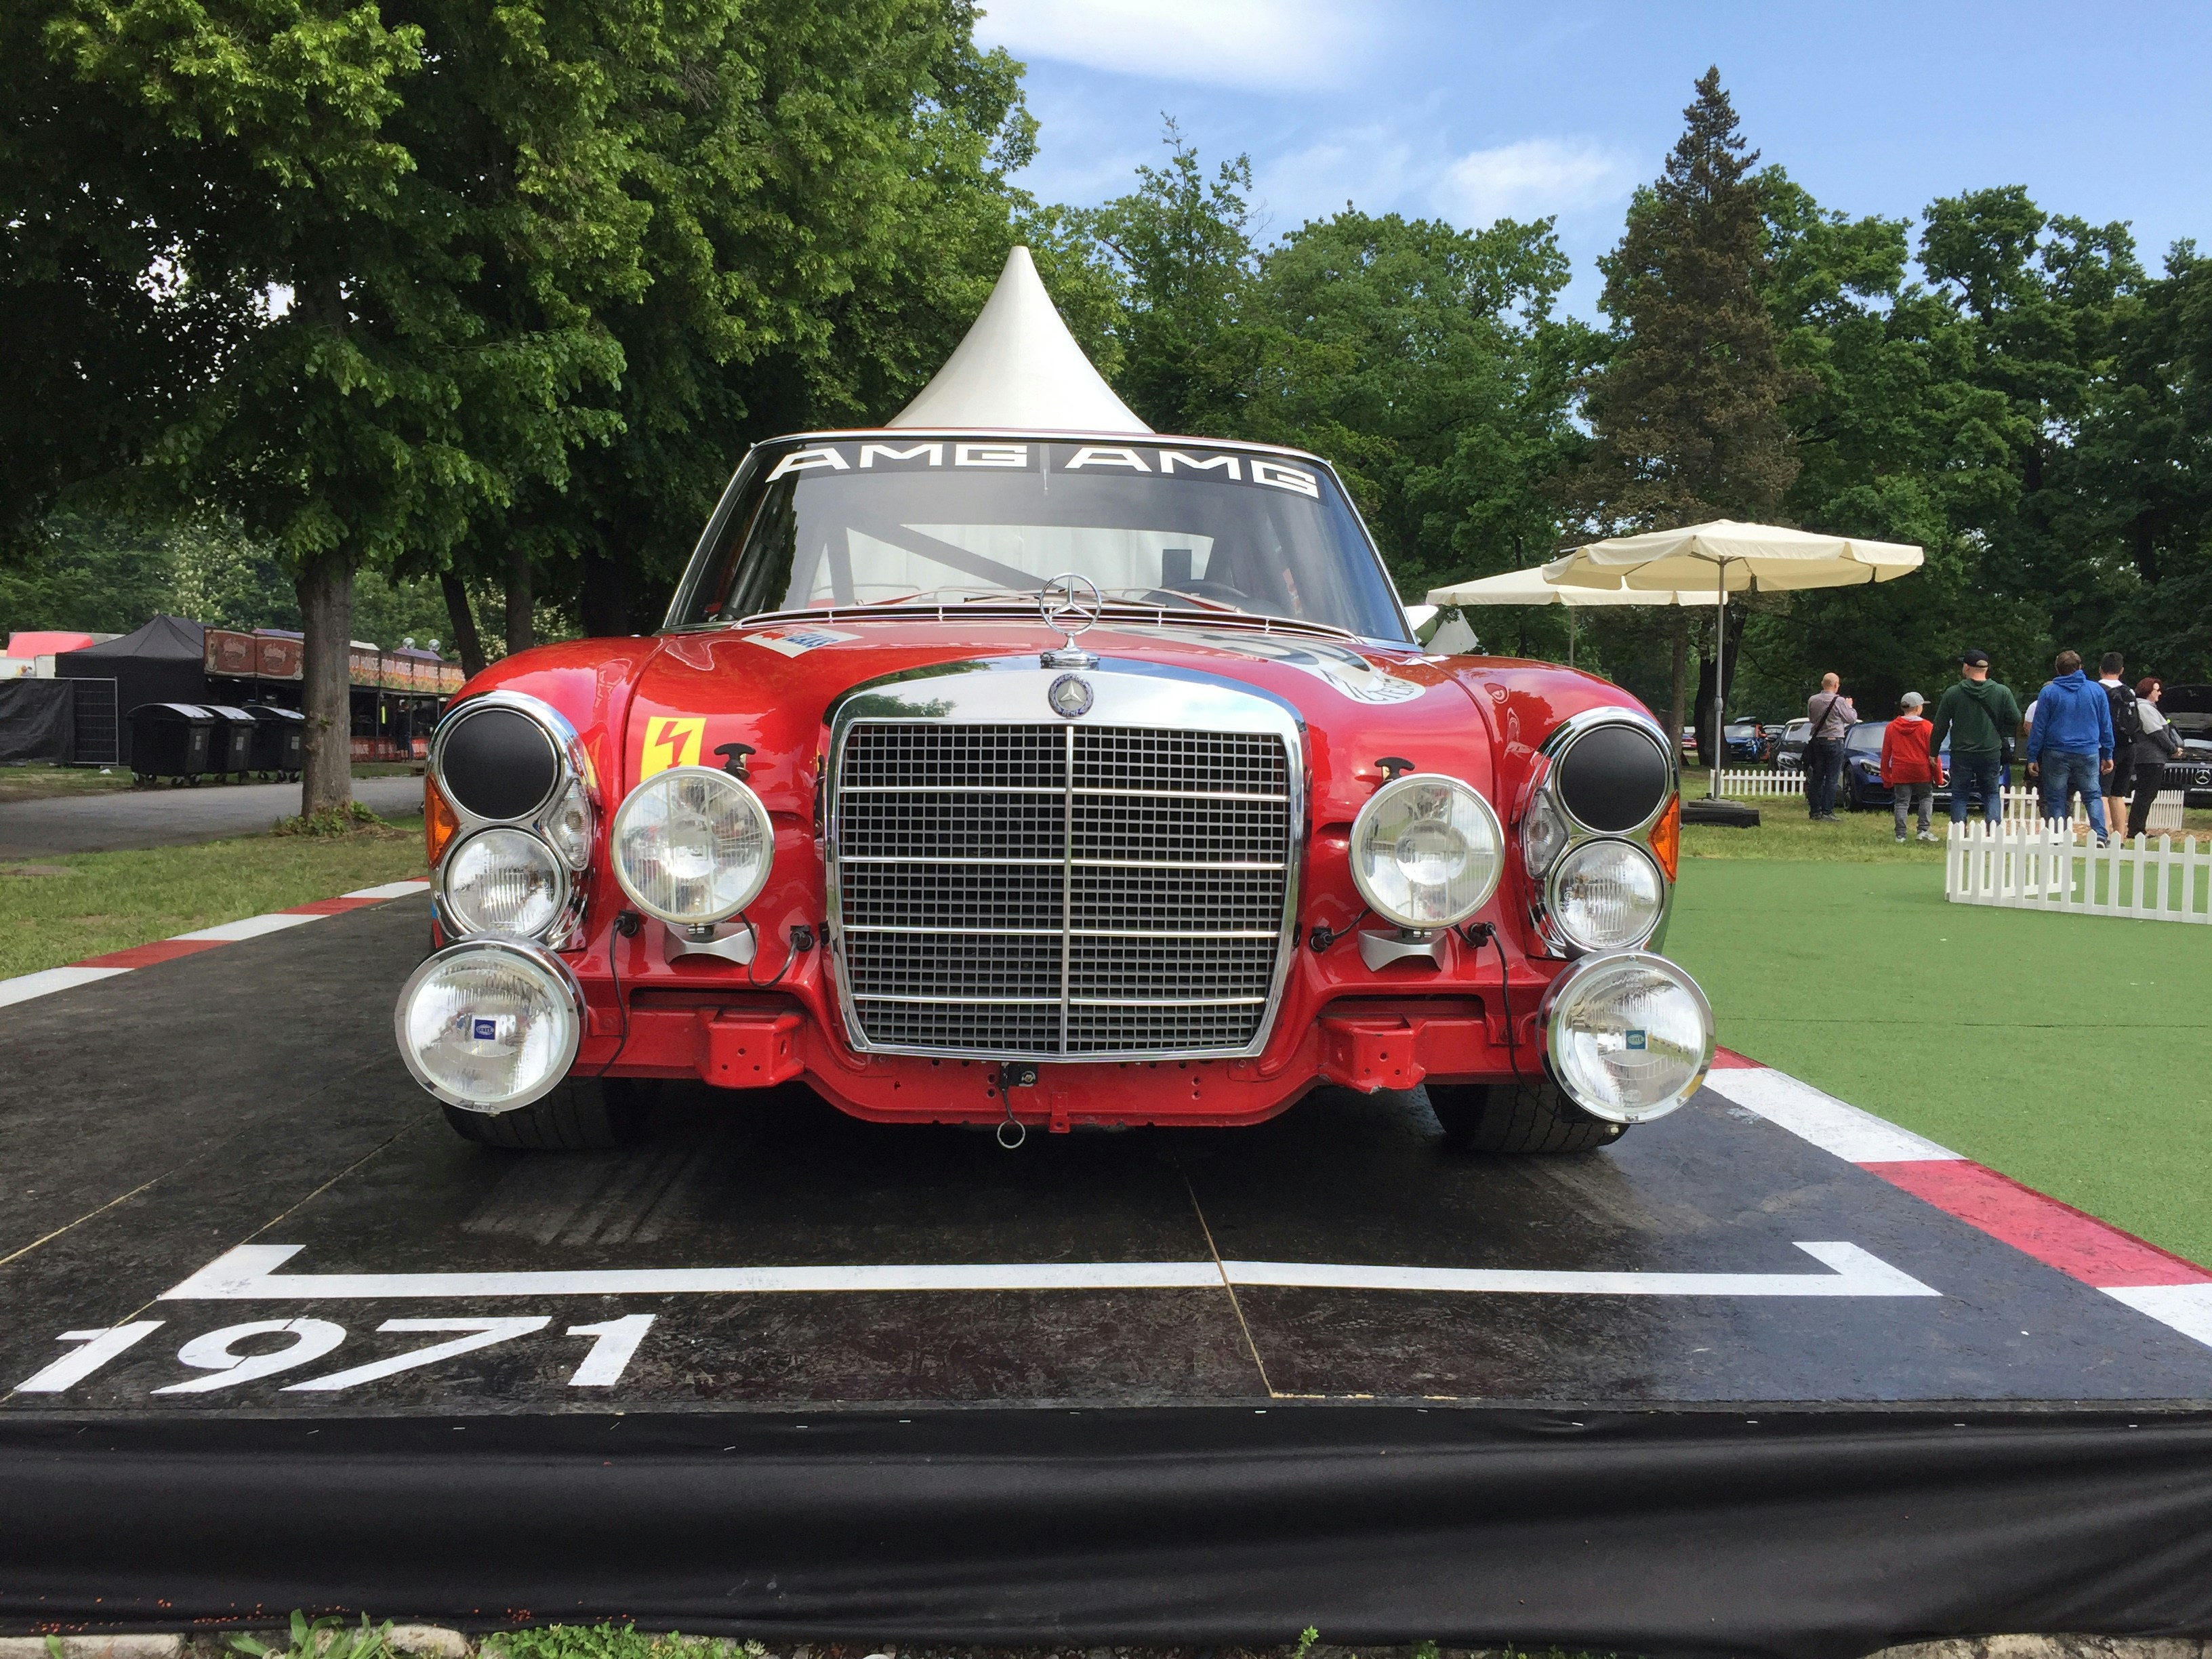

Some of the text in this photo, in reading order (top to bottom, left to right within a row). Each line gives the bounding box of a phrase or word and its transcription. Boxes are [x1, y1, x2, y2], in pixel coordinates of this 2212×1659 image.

[766, 443, 1319, 499] AMG AMG
[14, 1313, 656, 1394] 1971
